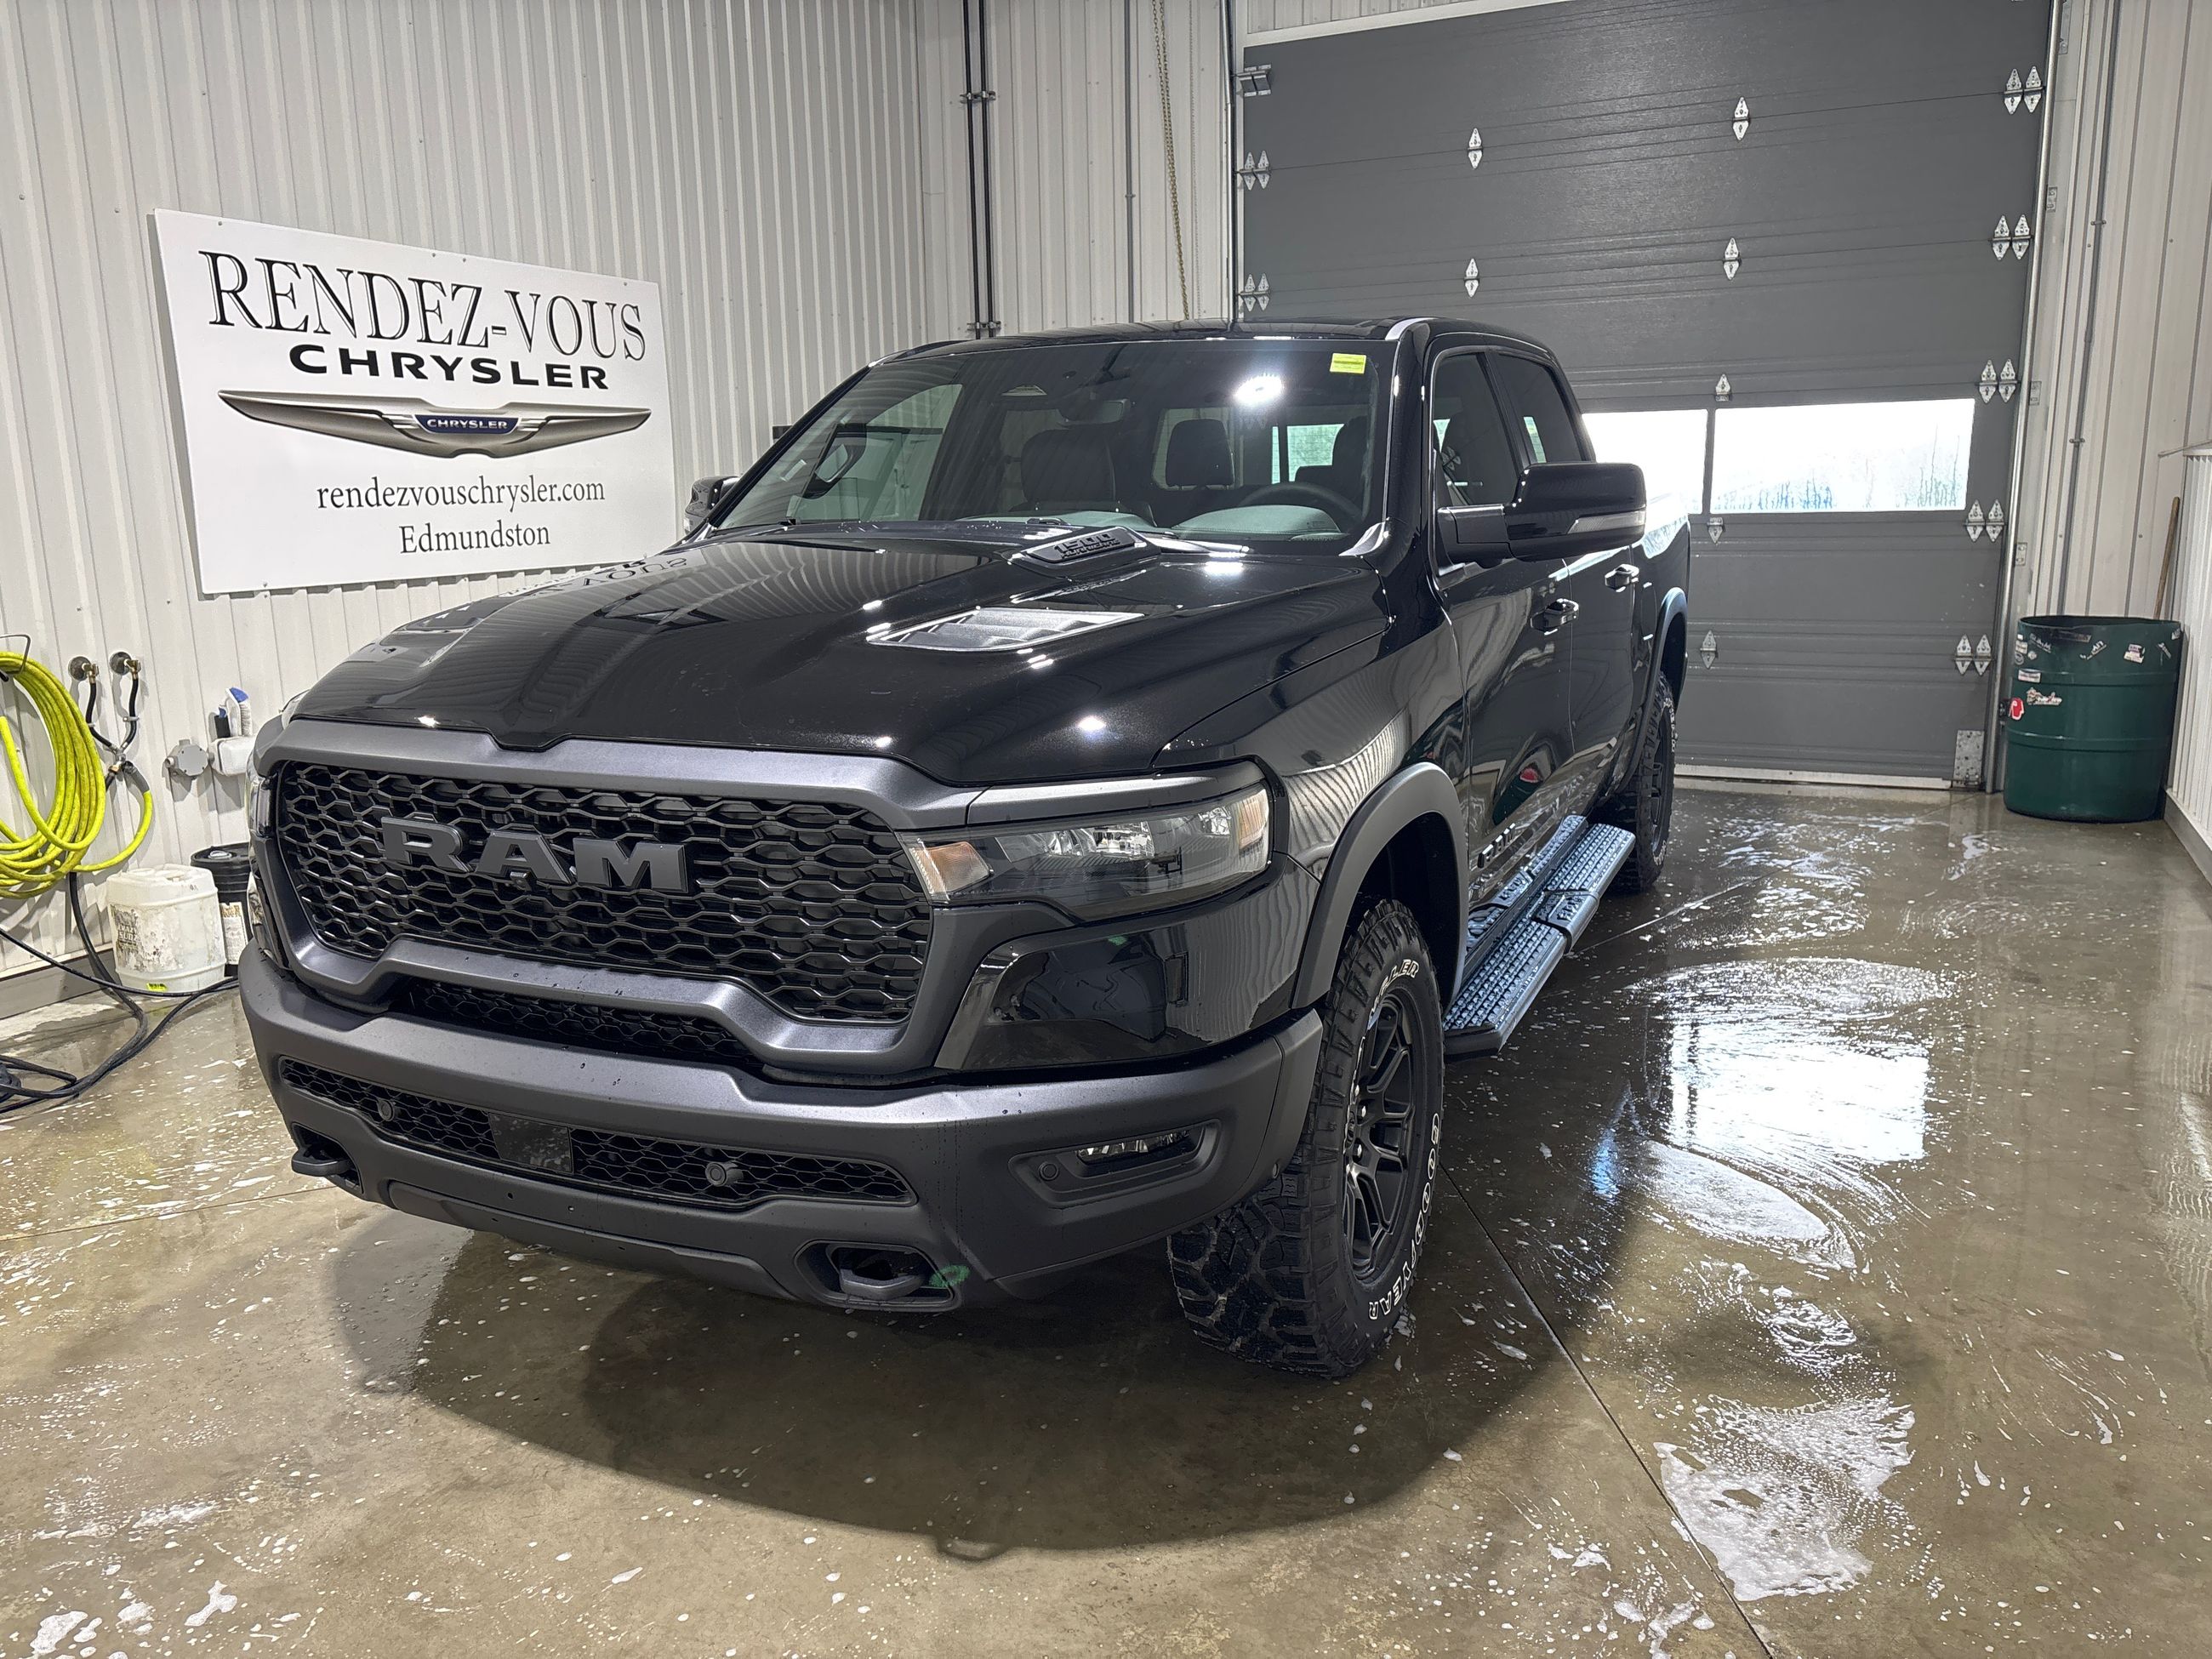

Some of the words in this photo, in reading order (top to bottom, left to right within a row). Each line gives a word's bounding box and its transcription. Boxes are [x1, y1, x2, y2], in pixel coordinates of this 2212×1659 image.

[198, 250, 646, 361] RENDEZ-VOUS
[288, 344, 609, 390] CHRYSLER
[427, 419, 508, 430] CHRYSLER
[316, 475, 606, 512] rendezvouschrysler.com
[398, 520, 551, 554] Edmundston
[1053, 533, 1116, 554] 1500
[380, 816, 689, 893] RAM
[1368, 1112, 1440, 1320] GOODYEAR
